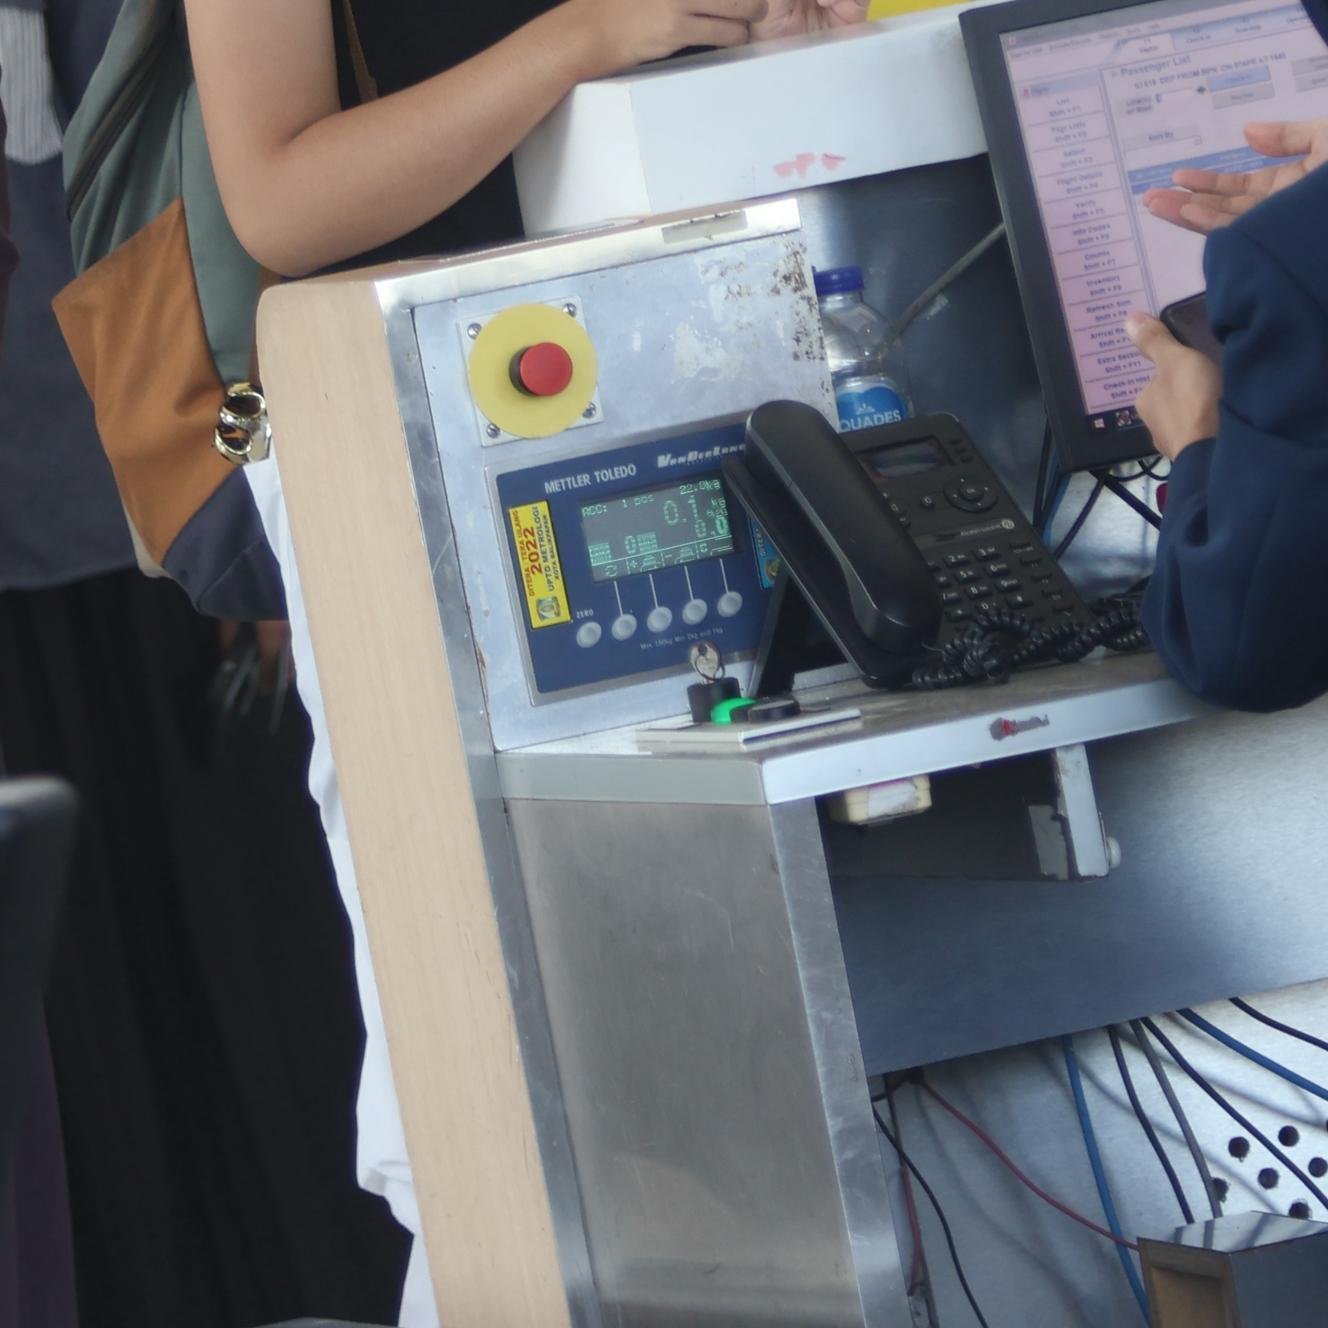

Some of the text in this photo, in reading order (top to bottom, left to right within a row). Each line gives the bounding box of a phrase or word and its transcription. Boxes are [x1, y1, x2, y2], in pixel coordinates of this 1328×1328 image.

[1120, 60, 1171, 78] Passenger
[839, 409, 902, 433] QUADES
[544, 463, 637, 494] METTLER TOLEDO
[533, 506, 549, 563] METROLOGI
[523, 526, 543, 575] 2022
